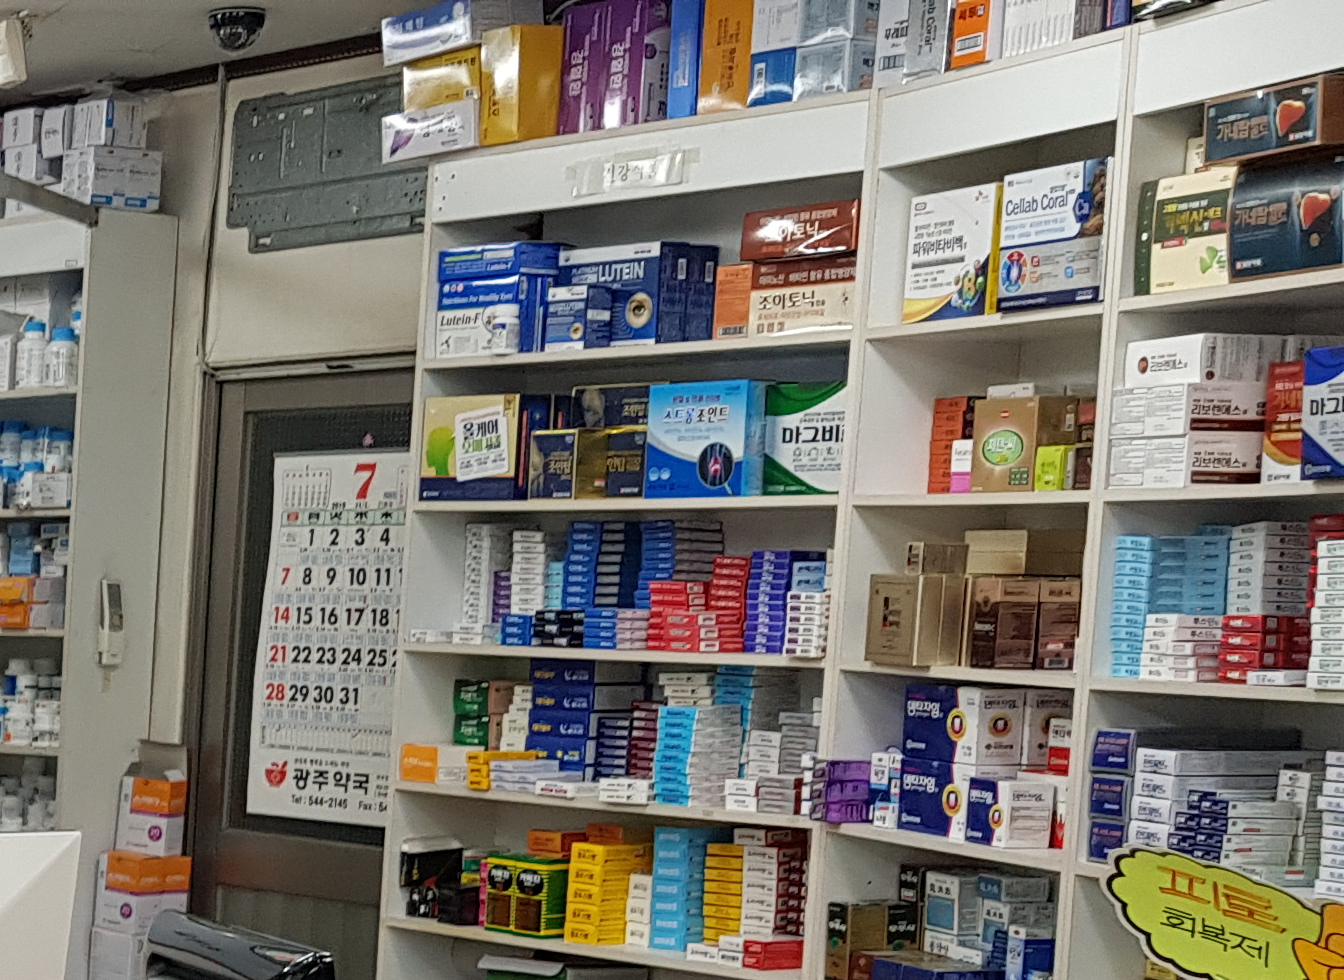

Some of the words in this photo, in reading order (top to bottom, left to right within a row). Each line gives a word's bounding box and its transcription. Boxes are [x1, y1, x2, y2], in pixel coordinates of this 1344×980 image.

[1006, 197, 1038, 216] Cellab
[1041, 191, 1069, 209] Coral
[767, 221, 819, 242] 아토닉
[598, 260, 645, 281] LUTEIN
[759, 290, 815, 311] 조아토닉
[441, 312, 482, 327] Lutein-F
[662, 404, 730, 426] 스트롱조인트
[781, 425, 845, 445] 마그비
[353, 462, 377, 500] 7
[308, 528, 315, 547] 1
[329, 528, 340, 547] 2
[355, 528, 366, 547] 3
[379, 528, 391, 547] 4
[281, 567, 291, 586] 7
[302, 567, 312, 586] 8
[326, 567, 337, 586] 9
[348, 567, 367, 587] 10
[374, 567, 392, 587] 11
[273, 606, 290, 625] 14
[295, 606, 313, 625] 15
[320, 606, 338, 626] 16
[345, 606, 364, 627] 17
[370, 606, 390, 627] 18
[269, 645, 288, 662] 21
[291, 646, 312, 664] 22
[316, 646, 337, 664] 23
[341, 646, 362, 666] 24
[366, 647, 388, 666] 25
[265, 683, 285, 701] 28
[289, 685, 310, 703] 29
[313, 686, 334, 704] 30
[339, 687, 359, 706] 31
[292, 768, 370, 795] 광주약국
[1157, 866, 1287, 935] 피로
[1159, 907, 1271, 968] 회복제
